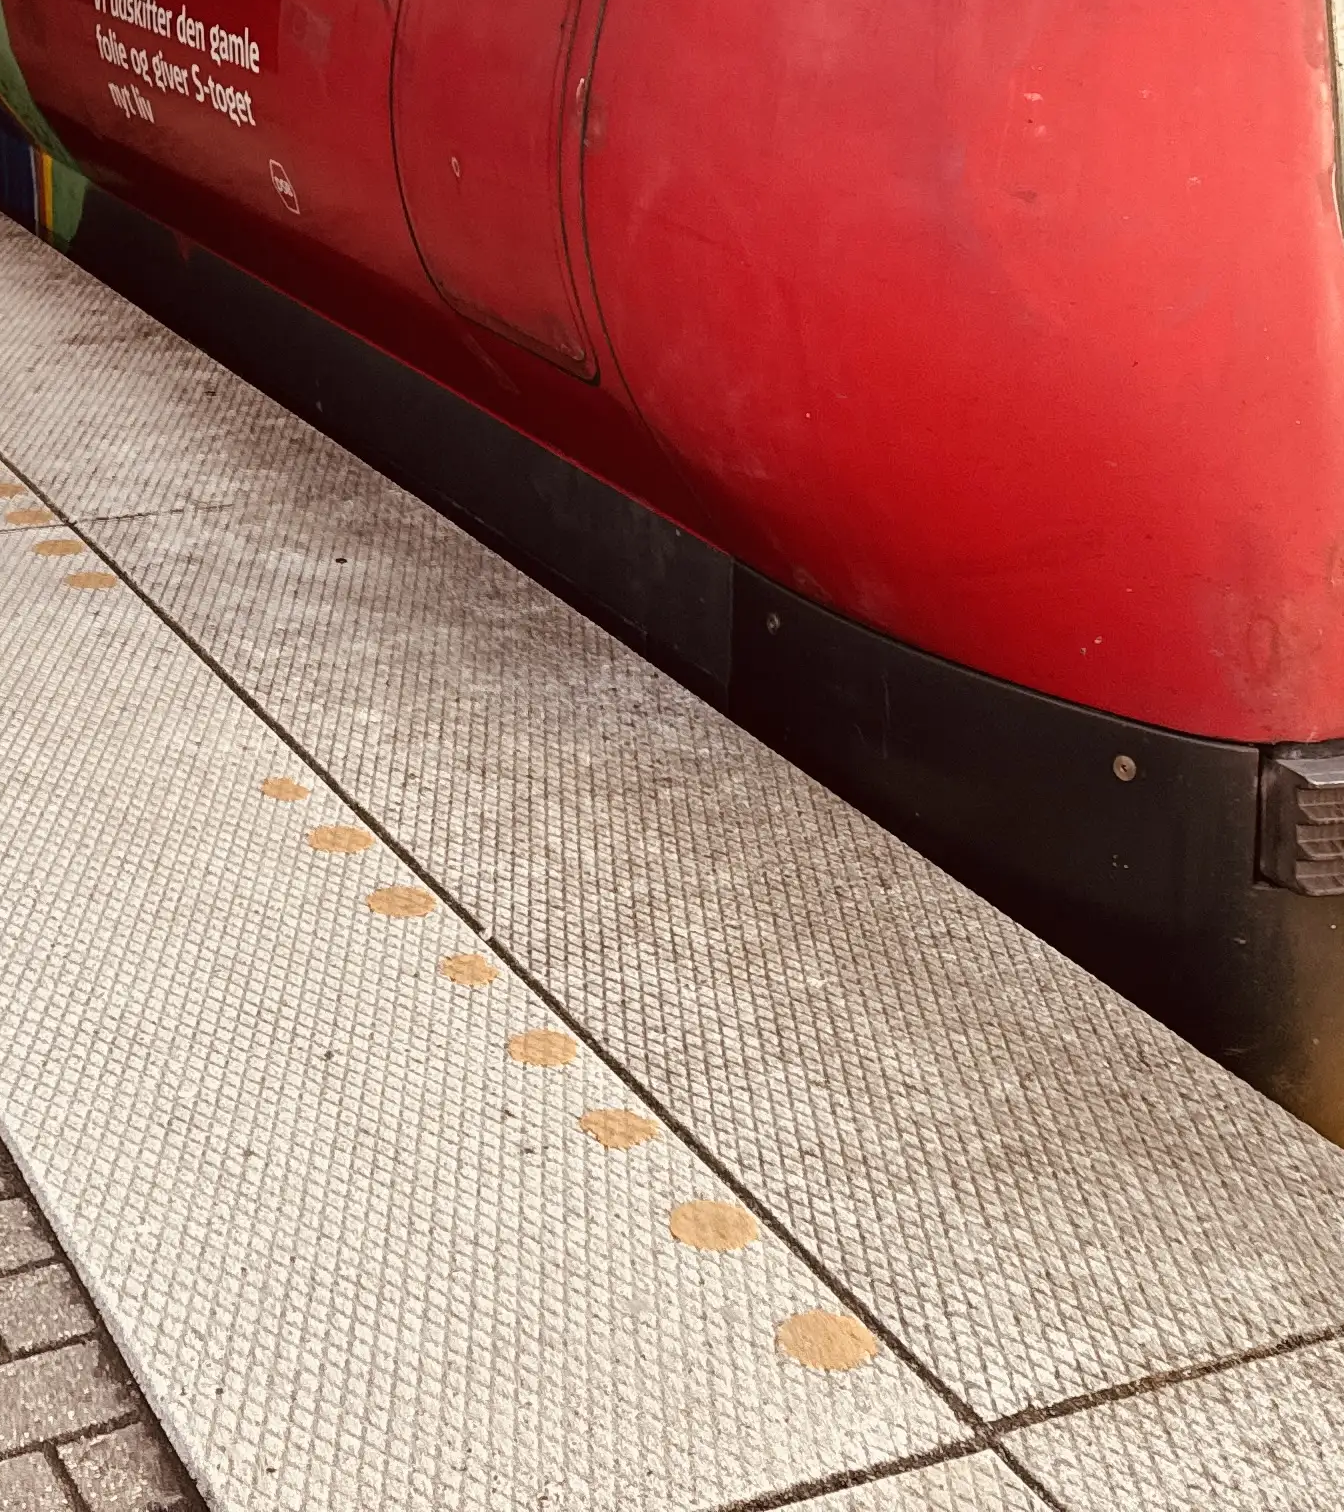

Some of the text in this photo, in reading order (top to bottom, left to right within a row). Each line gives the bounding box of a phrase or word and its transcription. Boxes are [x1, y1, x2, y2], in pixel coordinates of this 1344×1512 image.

[176, 4, 206, 52] den
[209, 24, 260, 74] gamle
[95, 23, 256, 128] folie og giver S-toget
[108, 82, 155, 124] nyt liv
